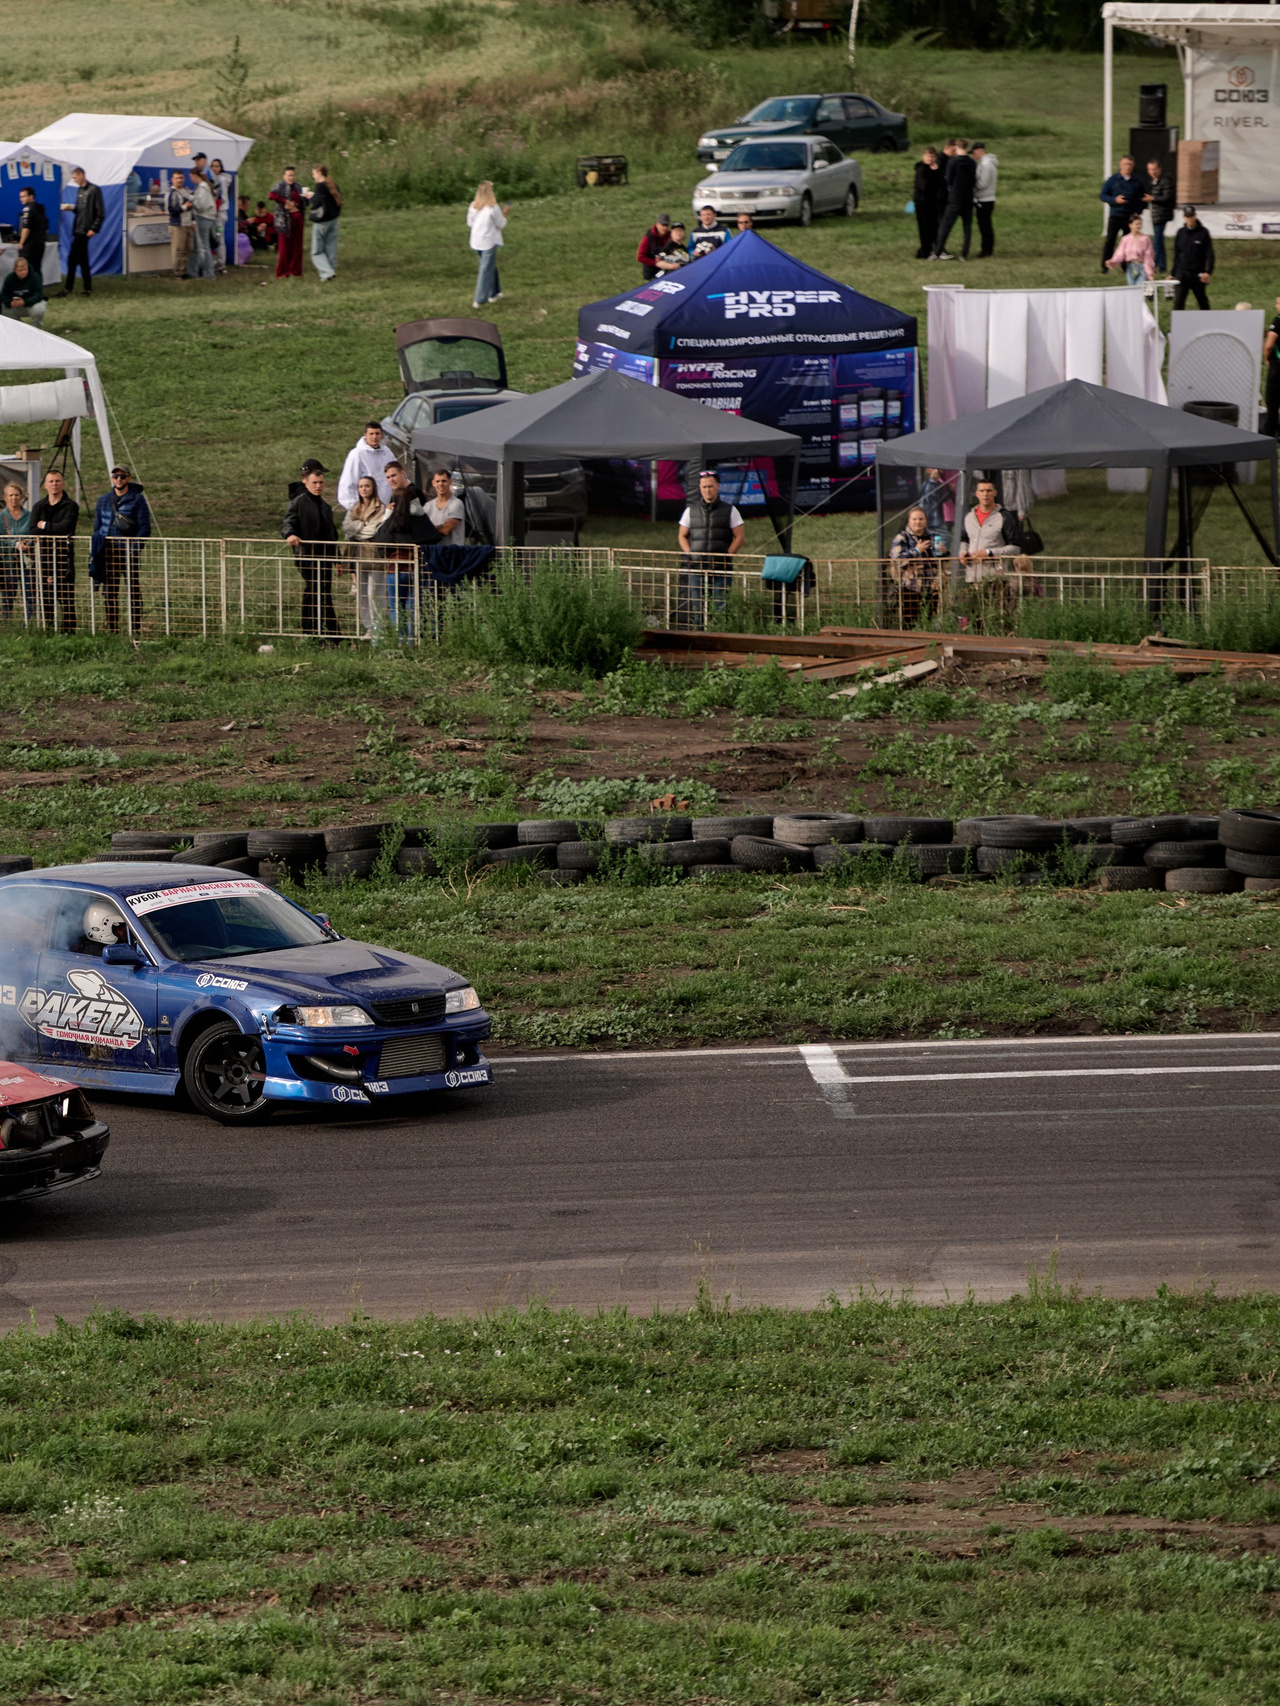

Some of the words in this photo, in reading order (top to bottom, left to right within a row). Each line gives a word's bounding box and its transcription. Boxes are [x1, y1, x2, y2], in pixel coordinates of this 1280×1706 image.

[1214, 89, 1269, 103] СОЮЗ
[725, 290, 843, 304] HYPER
[725, 303, 796, 319] PRO
[676, 333, 795, 348] СПЕЦИАЛИЗИРОВАННЫЕ
[796, 330, 857, 343] ОТРАСЛЕВЫЕ
[859, 328, 905, 341] РЕШЕНИЯ
[677, 362, 725, 372] HYPER
[712, 369, 757, 379] RACING
[676, 381, 712, 390] ГОНОЧНОЕ
[712, 381, 744, 389] ТОПЛИВО
[128, 891, 162, 906] КУБОК
[161, 882, 233, 898] БАРНАУЛЬСКОЙ
[211, 976, 249, 991] СОЮЗ
[20, 988, 142, 1039] РАКЕТА
[56, 1030, 90, 1041] ГОНОЧНАЯ
[90, 1036, 125, 1047] КОМАНДА
[459, 1069, 489, 1083] СОЮЗ
